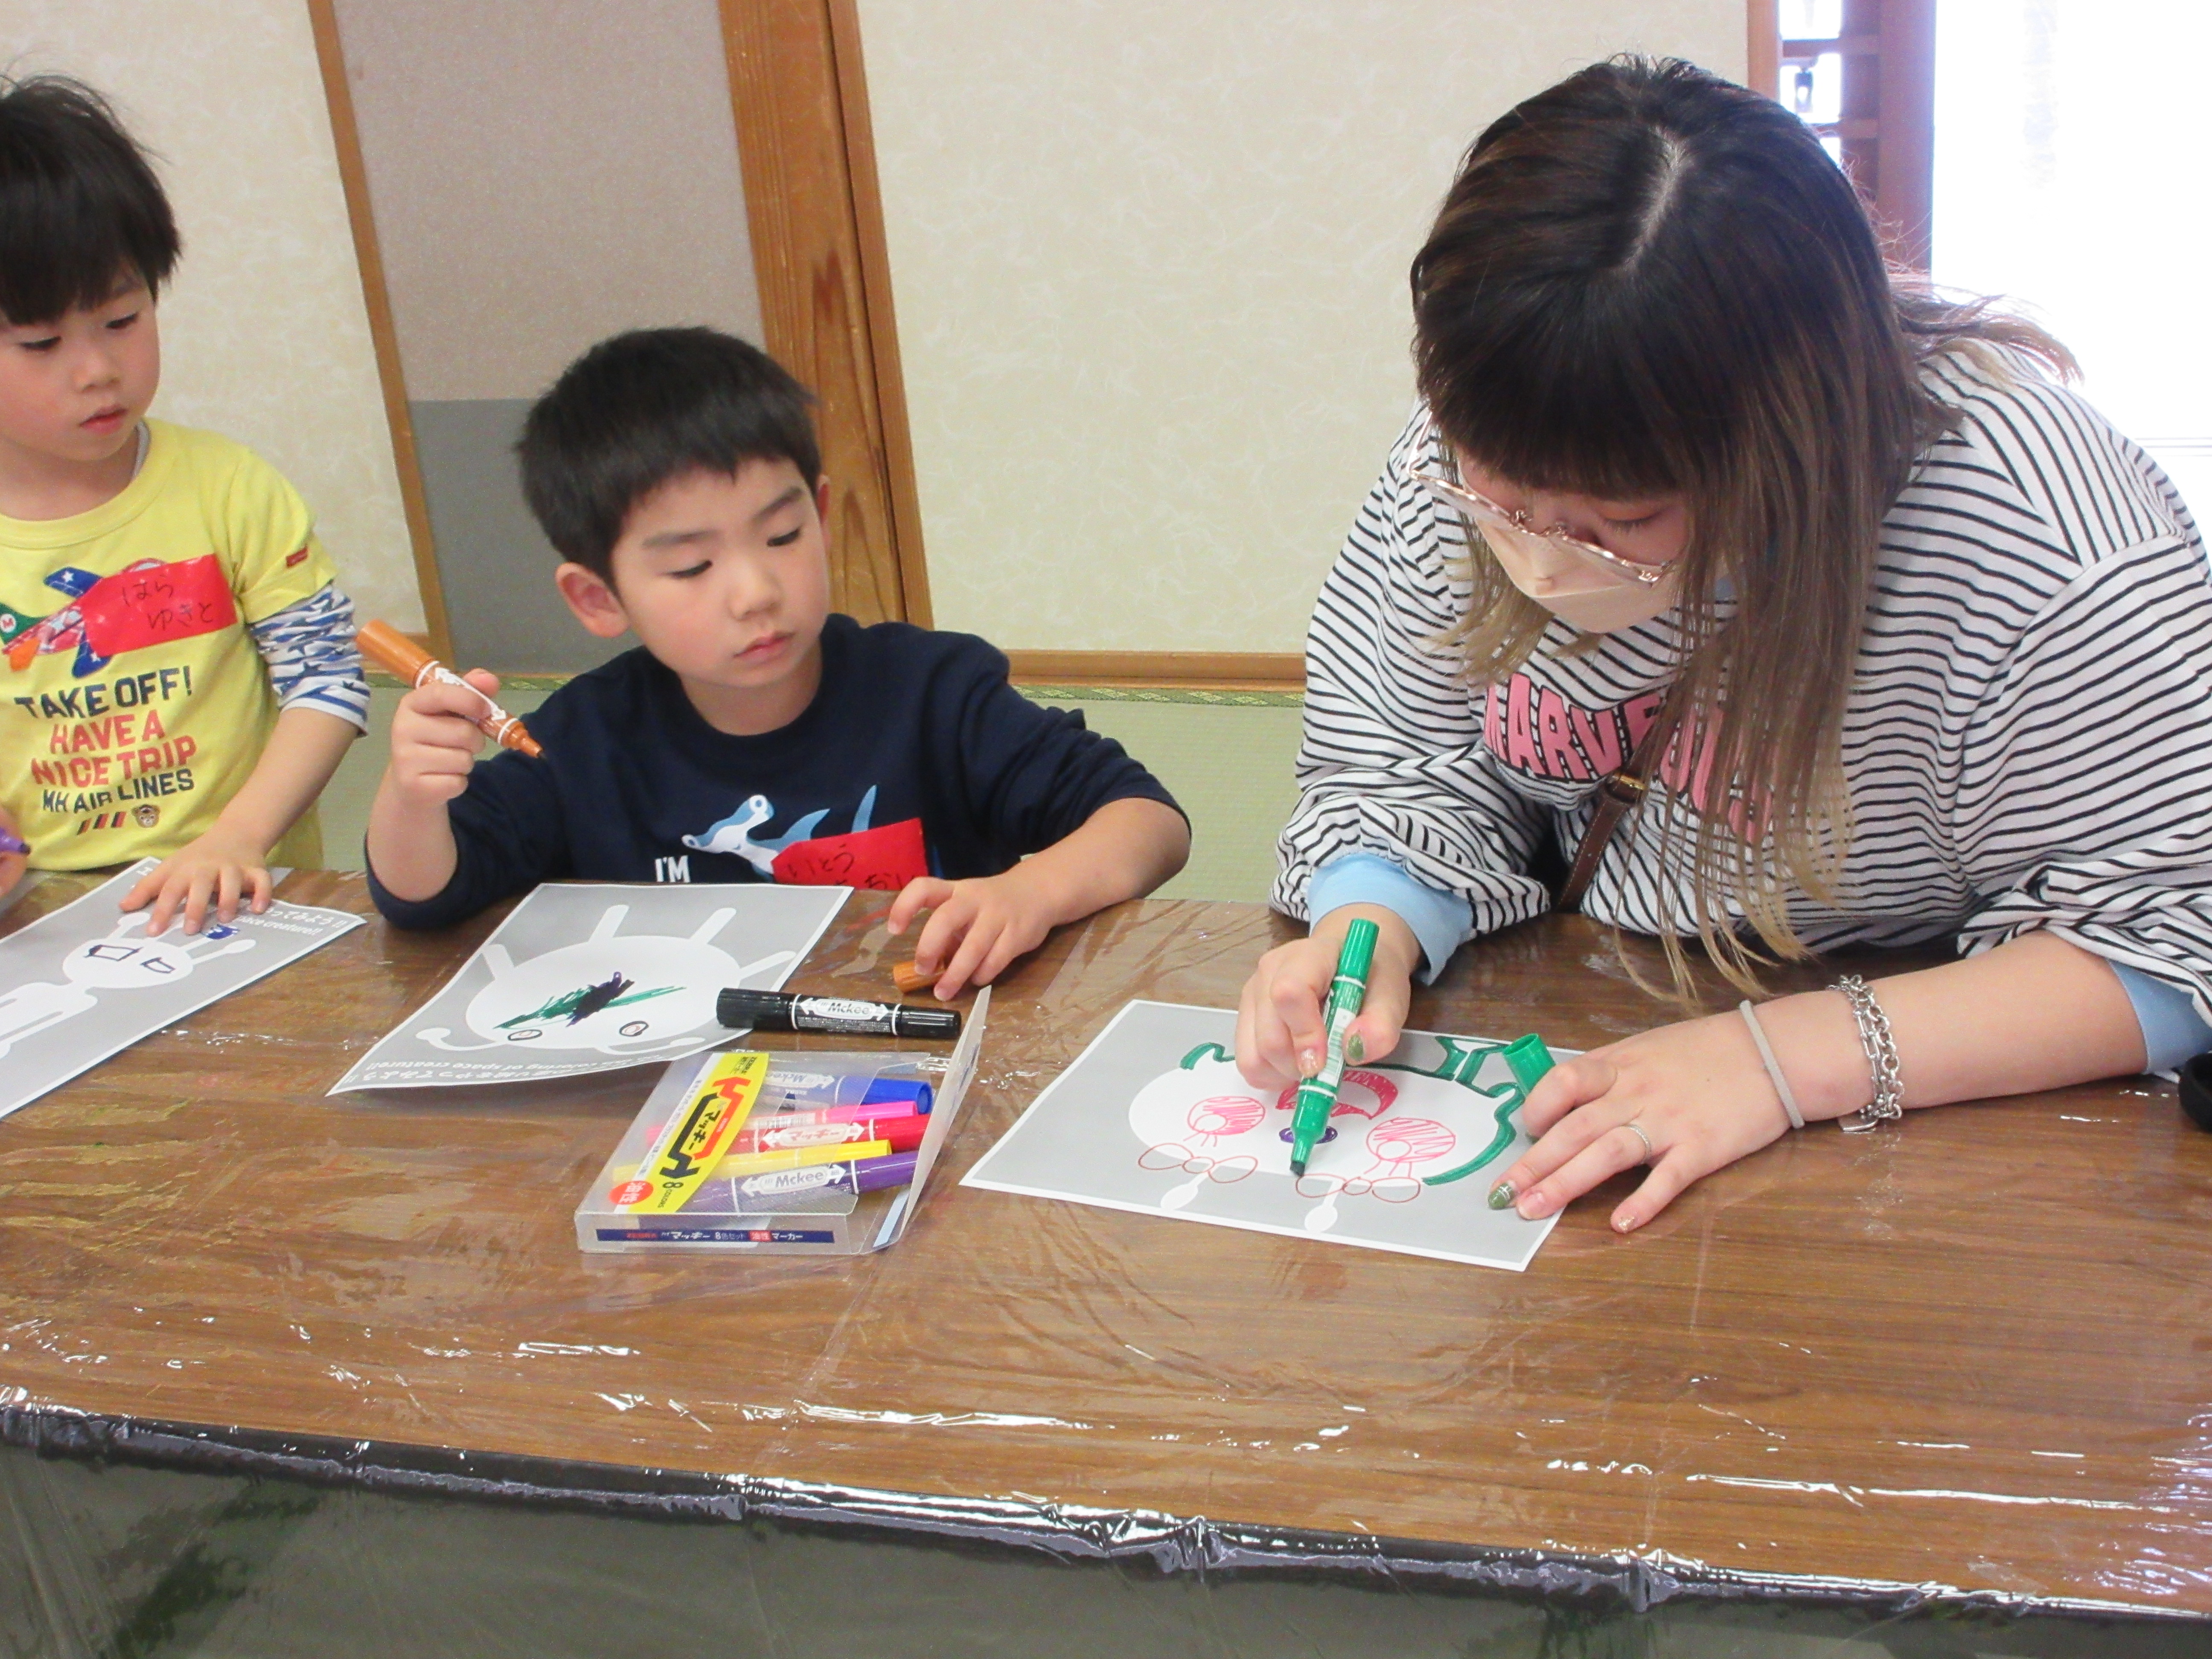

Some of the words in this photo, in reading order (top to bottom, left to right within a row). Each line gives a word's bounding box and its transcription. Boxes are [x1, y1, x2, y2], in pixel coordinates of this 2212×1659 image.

[122, 579, 173, 607] はら
[147, 602, 212, 631] ゆきと
[14, 683, 108, 719] TAKE
[115, 666, 192, 707] OFF!
[50, 714, 136, 755] HAVE
[142, 710, 166, 741] A
[31, 757, 111, 788] NICE
[116, 736, 197, 780] TRIP
[74, 792, 113, 813] AIR
[118, 768, 194, 800] LINES
[655, 855, 690, 882] I'M
[827, 1002, 870, 1015] Mckee
[689, 1110, 720, 1150] マッキー
[775, 1172, 824, 1187] Mckee
[771, 1232, 803, 1240] マーカー
